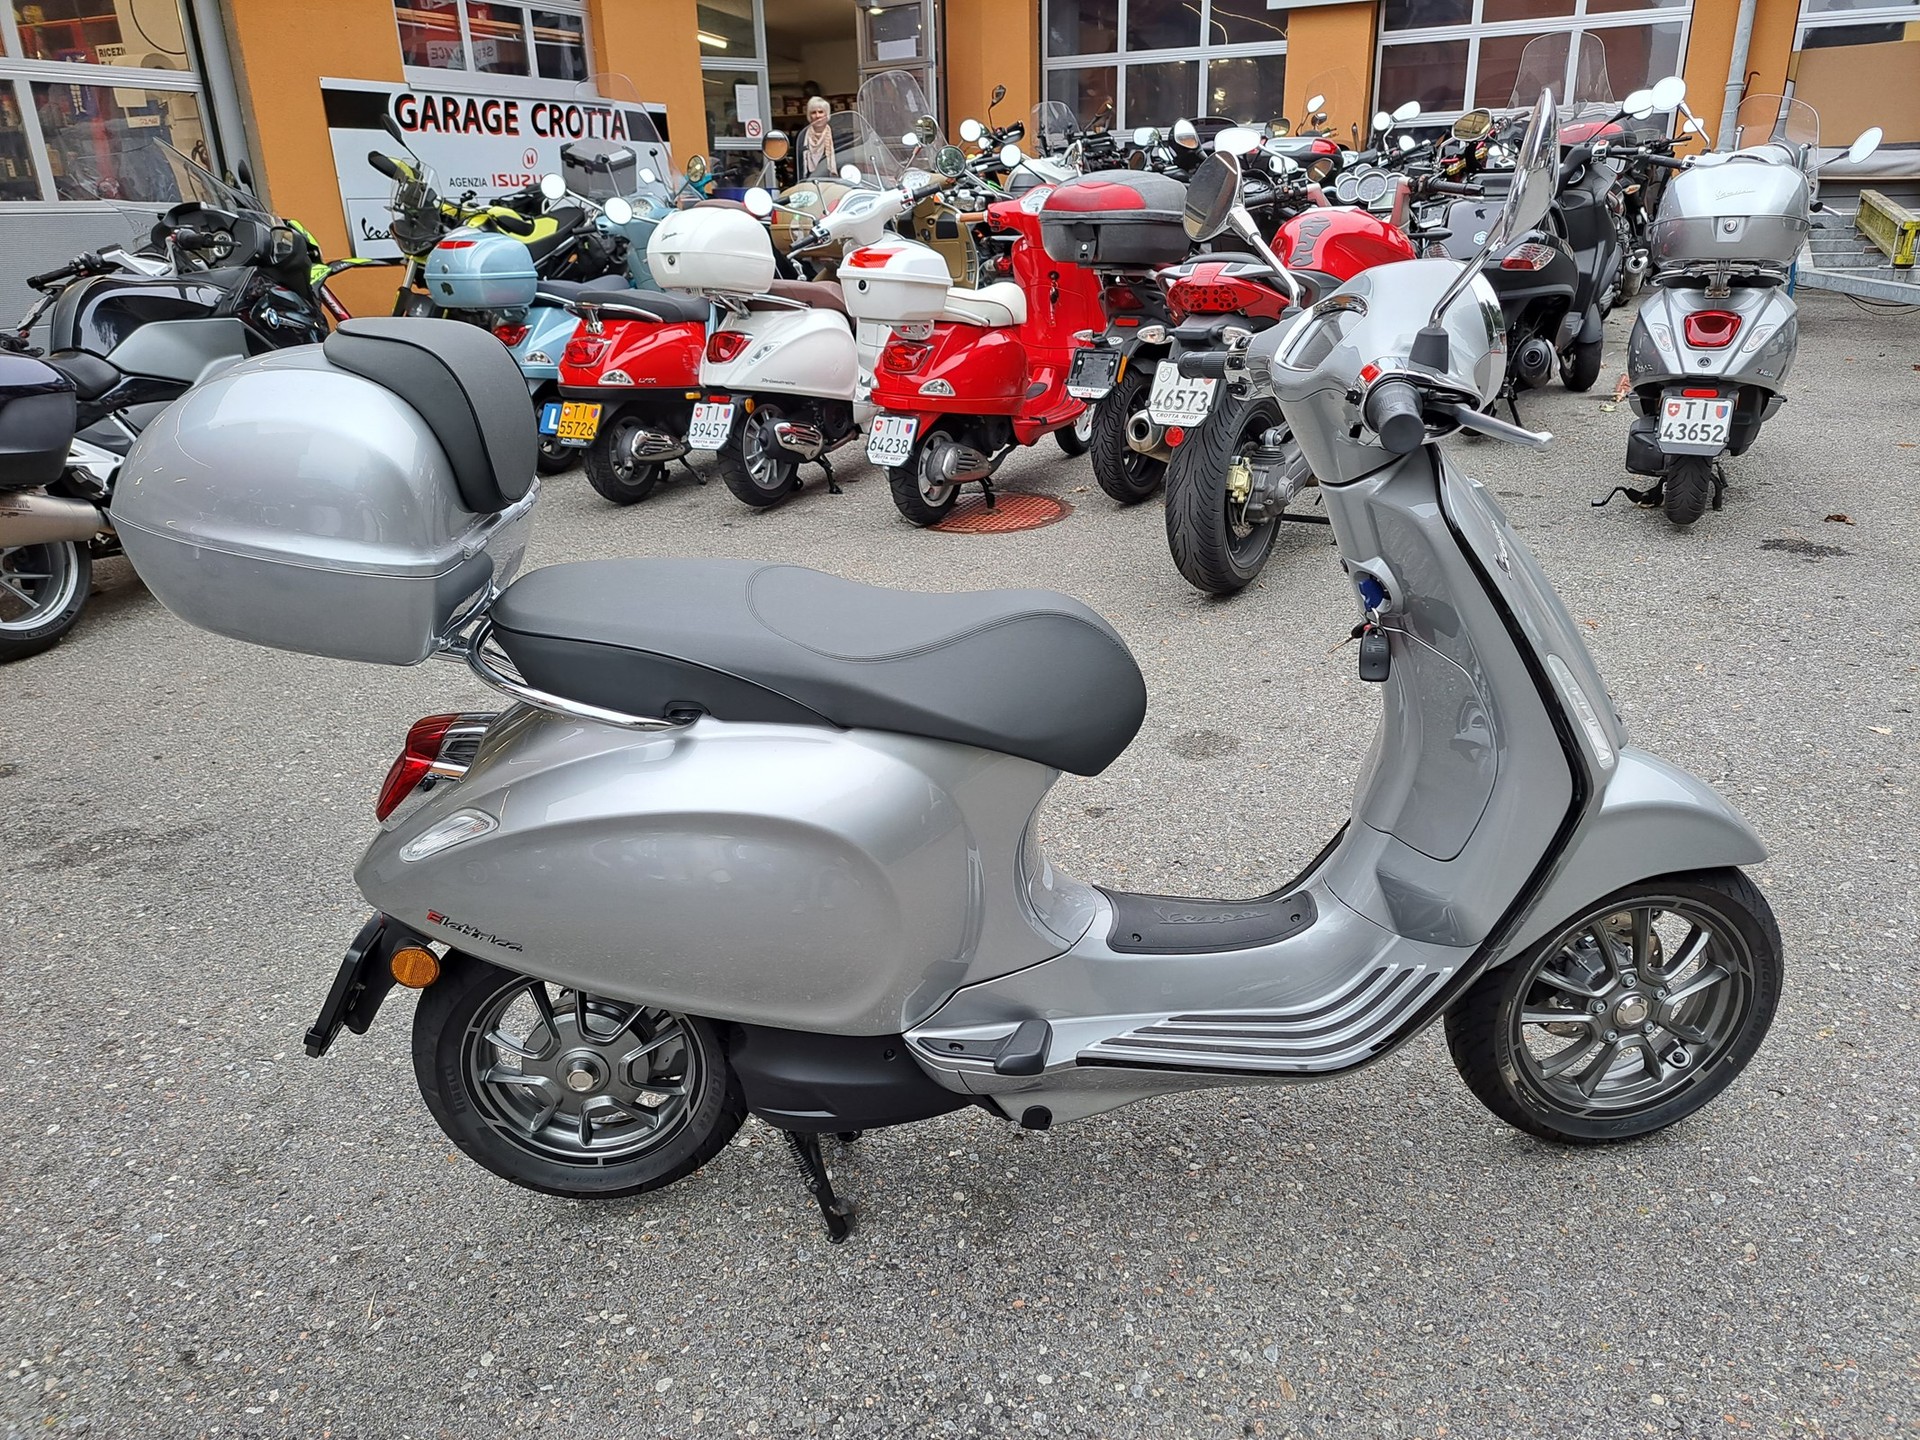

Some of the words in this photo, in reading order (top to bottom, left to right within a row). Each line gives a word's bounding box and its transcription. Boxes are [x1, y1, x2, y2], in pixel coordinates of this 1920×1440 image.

[98, 47, 126, 57] RICEZI
[394, 93, 520, 136] GARAGE
[530, 102, 628, 141] CROTTA
[449, 174, 488, 188] AGENZIA
[491, 173, 544, 187] ISUZU
[361, 217, 394, 241] Ves
[1152, 389, 1209, 412] 46573
[548, 408, 559, 430] L
[560, 420, 594, 437] 55726
[691, 422, 728, 438] 39457
[1663, 422, 1725, 443] 43652
[870, 436, 909, 455] 64238
[426, 908, 523, 953] Elettrica
